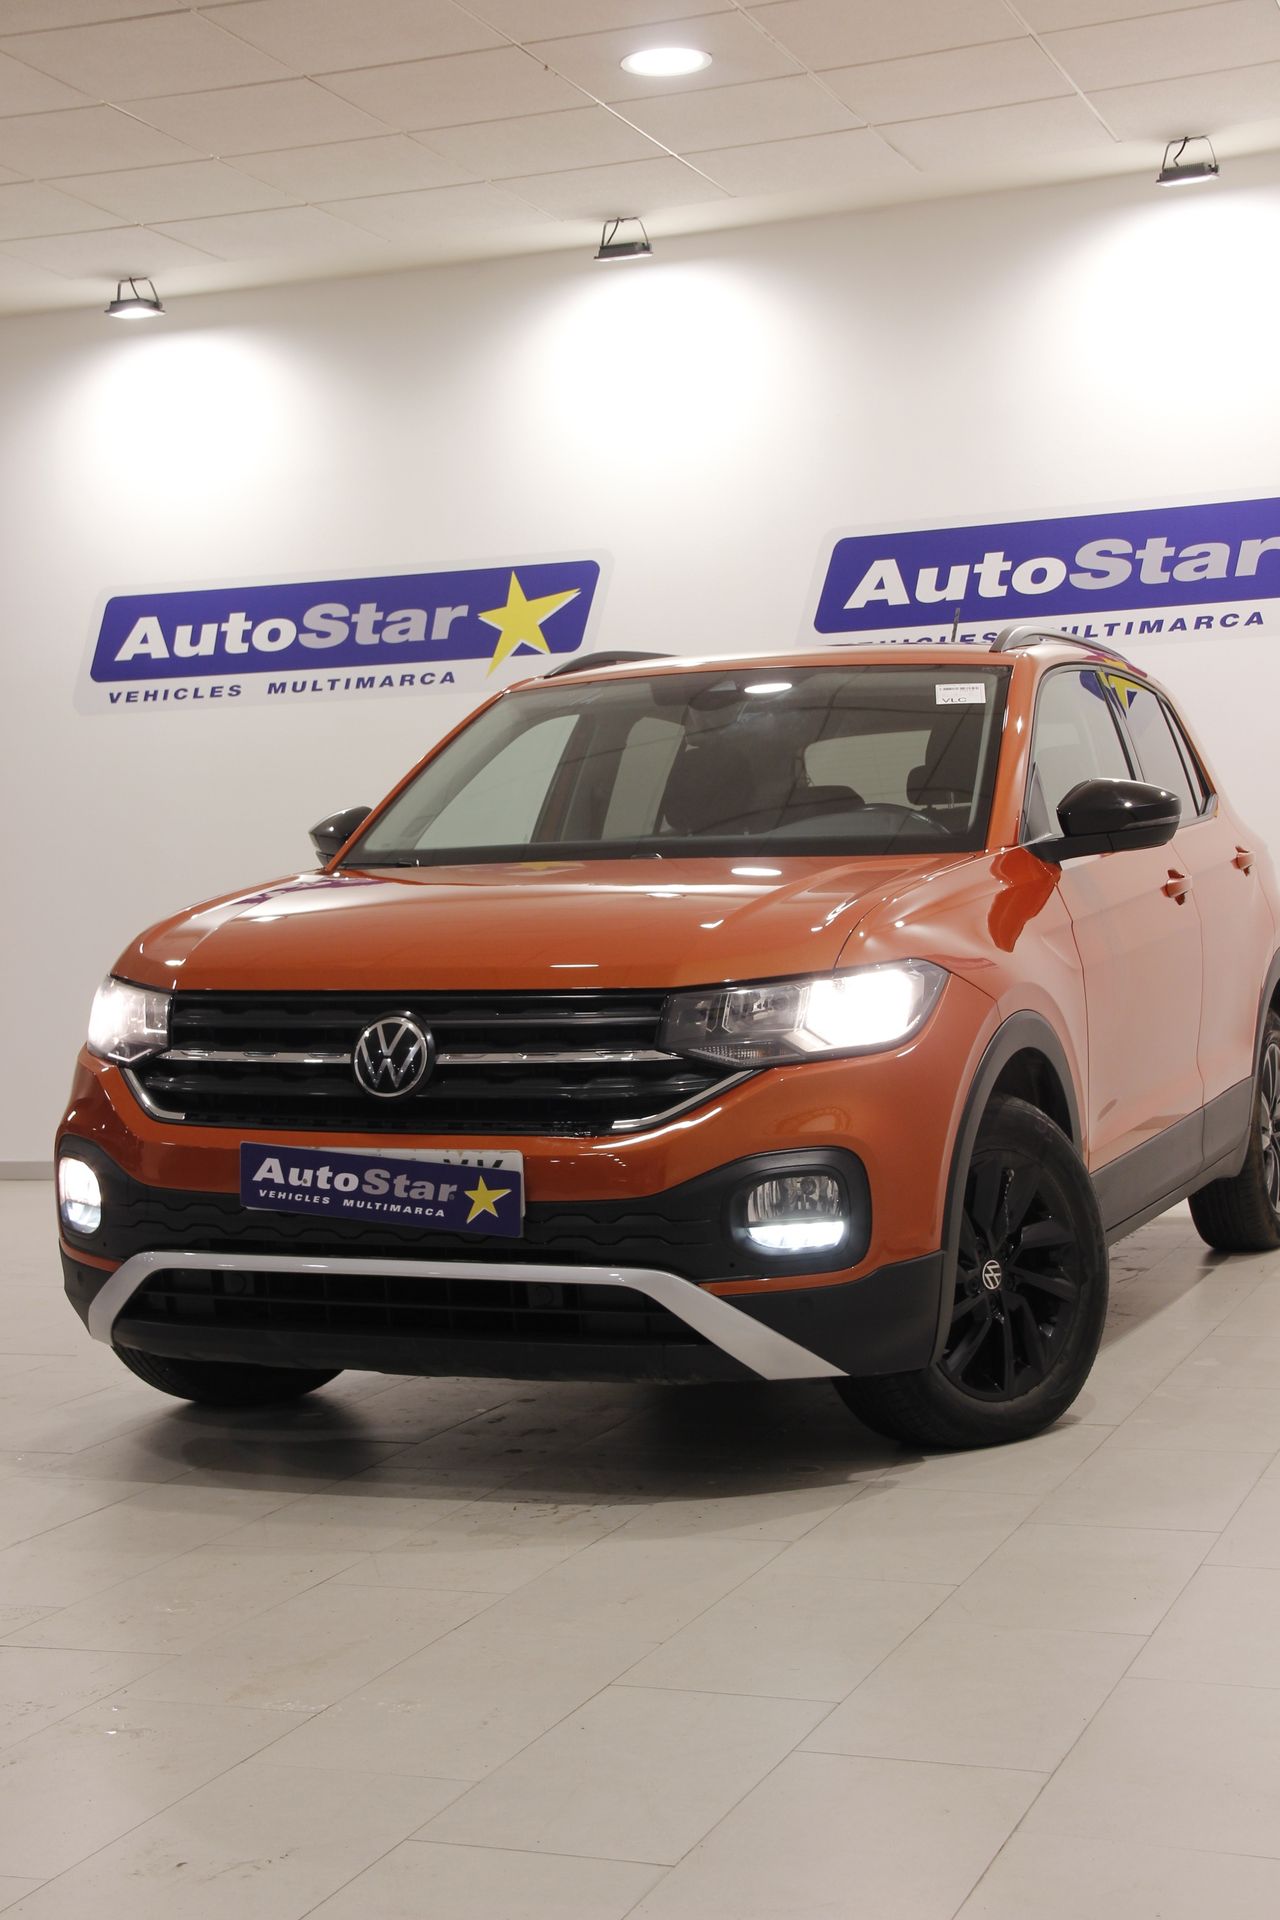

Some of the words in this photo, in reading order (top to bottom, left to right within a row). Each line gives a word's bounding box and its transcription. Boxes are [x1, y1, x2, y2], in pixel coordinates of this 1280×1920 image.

[843, 536, 1280, 609] AutoStar
[113, 602, 469, 662] AutoStar
[1060, 611, 1264, 638] LTIMARCA
[108, 684, 243, 704] VEHICLES
[267, 671, 457, 696] MULTIMARCA
[252, 1157, 458, 1202] AutoStar
[258, 1189, 331, 1205] VEHICLES
[342, 1199, 446, 1218] MULTIMARCA
